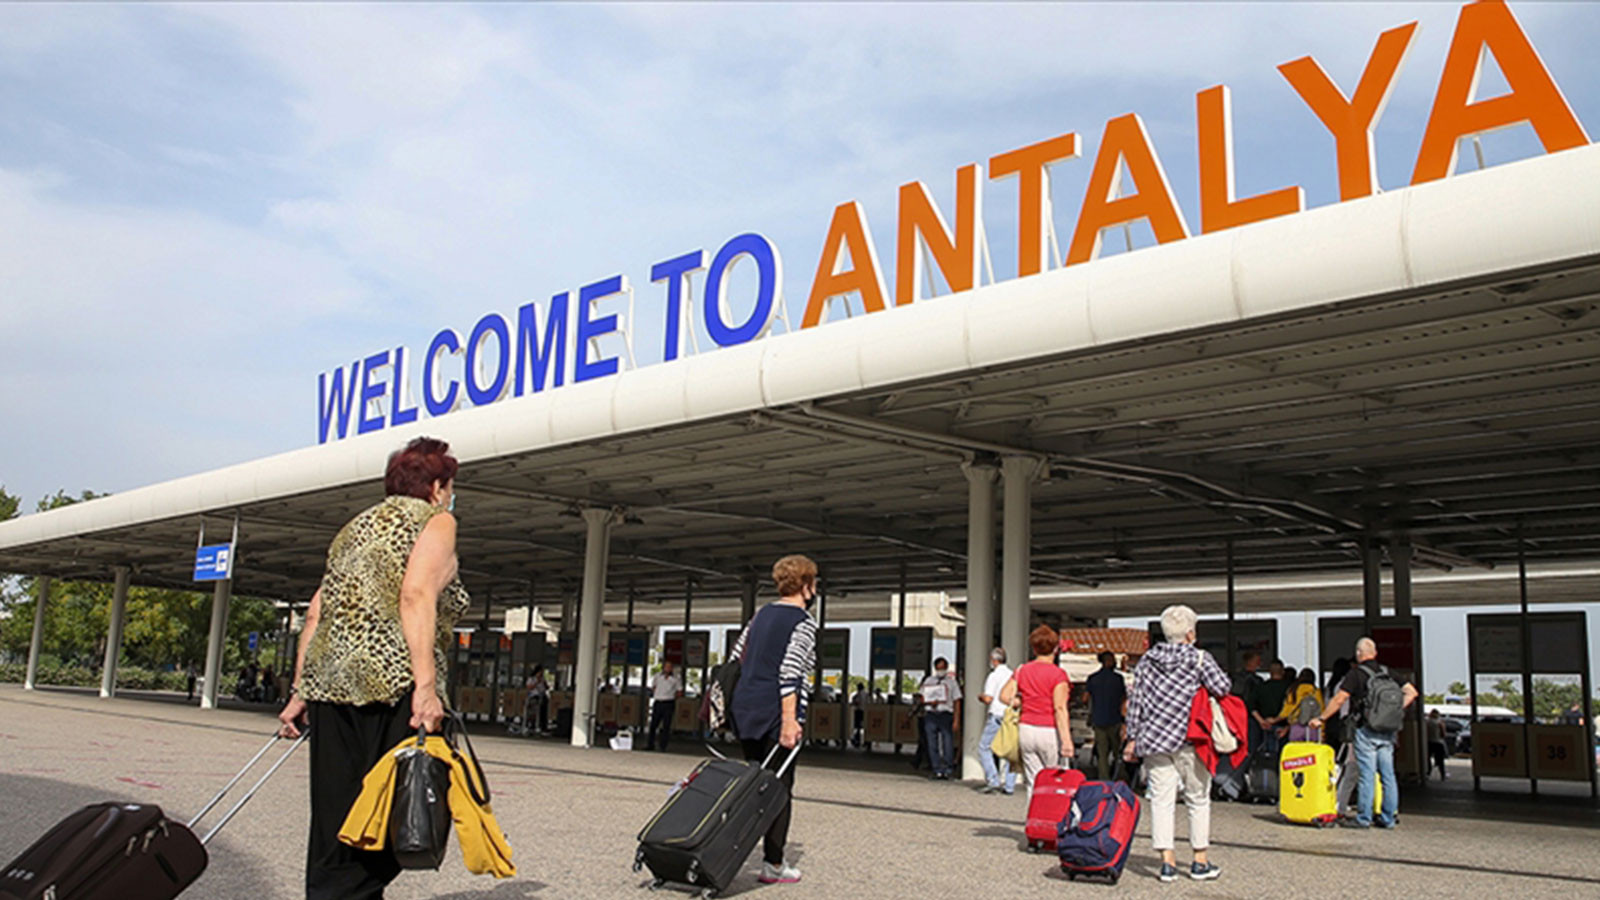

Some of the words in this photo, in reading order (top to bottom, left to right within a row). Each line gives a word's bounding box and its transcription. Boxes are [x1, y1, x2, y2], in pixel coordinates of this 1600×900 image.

[318, 275, 623, 443] WELCOME
[651, 233, 777, 361] TO
[802, 0, 1589, 328] ANTALYA
[1488, 744, 1507, 757] 37
[1547, 745, 1567, 760] 38
